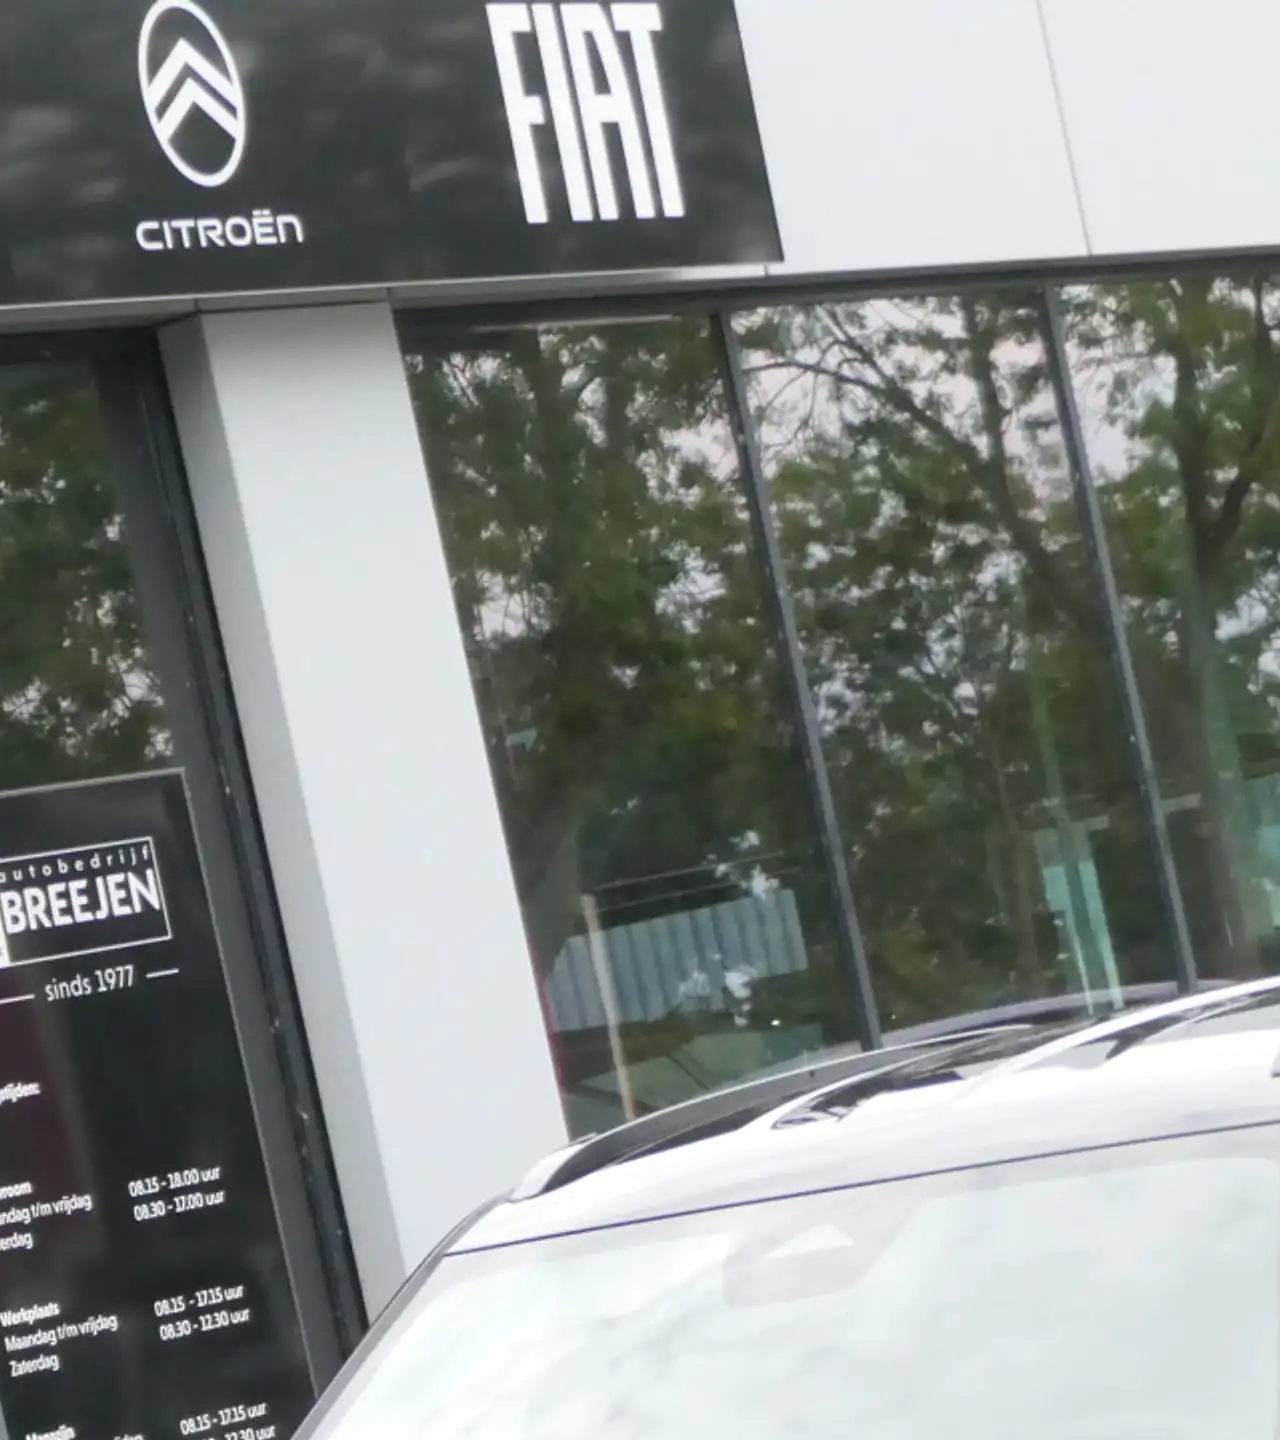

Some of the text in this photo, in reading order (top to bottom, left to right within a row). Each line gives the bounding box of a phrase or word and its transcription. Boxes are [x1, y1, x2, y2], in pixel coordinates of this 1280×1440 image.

[486, 2, 684, 223] FIAT
[0, 868, 161, 934] BREEJEN
[44, 964, 135, 1002] sinds 1977
[52, 1194, 93, 1215] vrijdag
[200, 1166, 221, 1182] uur
[205, 1191, 225, 1205] uur
[4, 1329, 57, 1352] Maandag
[78, 1314, 118, 1336] vrijdag
[224, 1285, 244, 1300] uur
[230, 1308, 251, 1324] uur
[247, 1402, 267, 1419] uur
